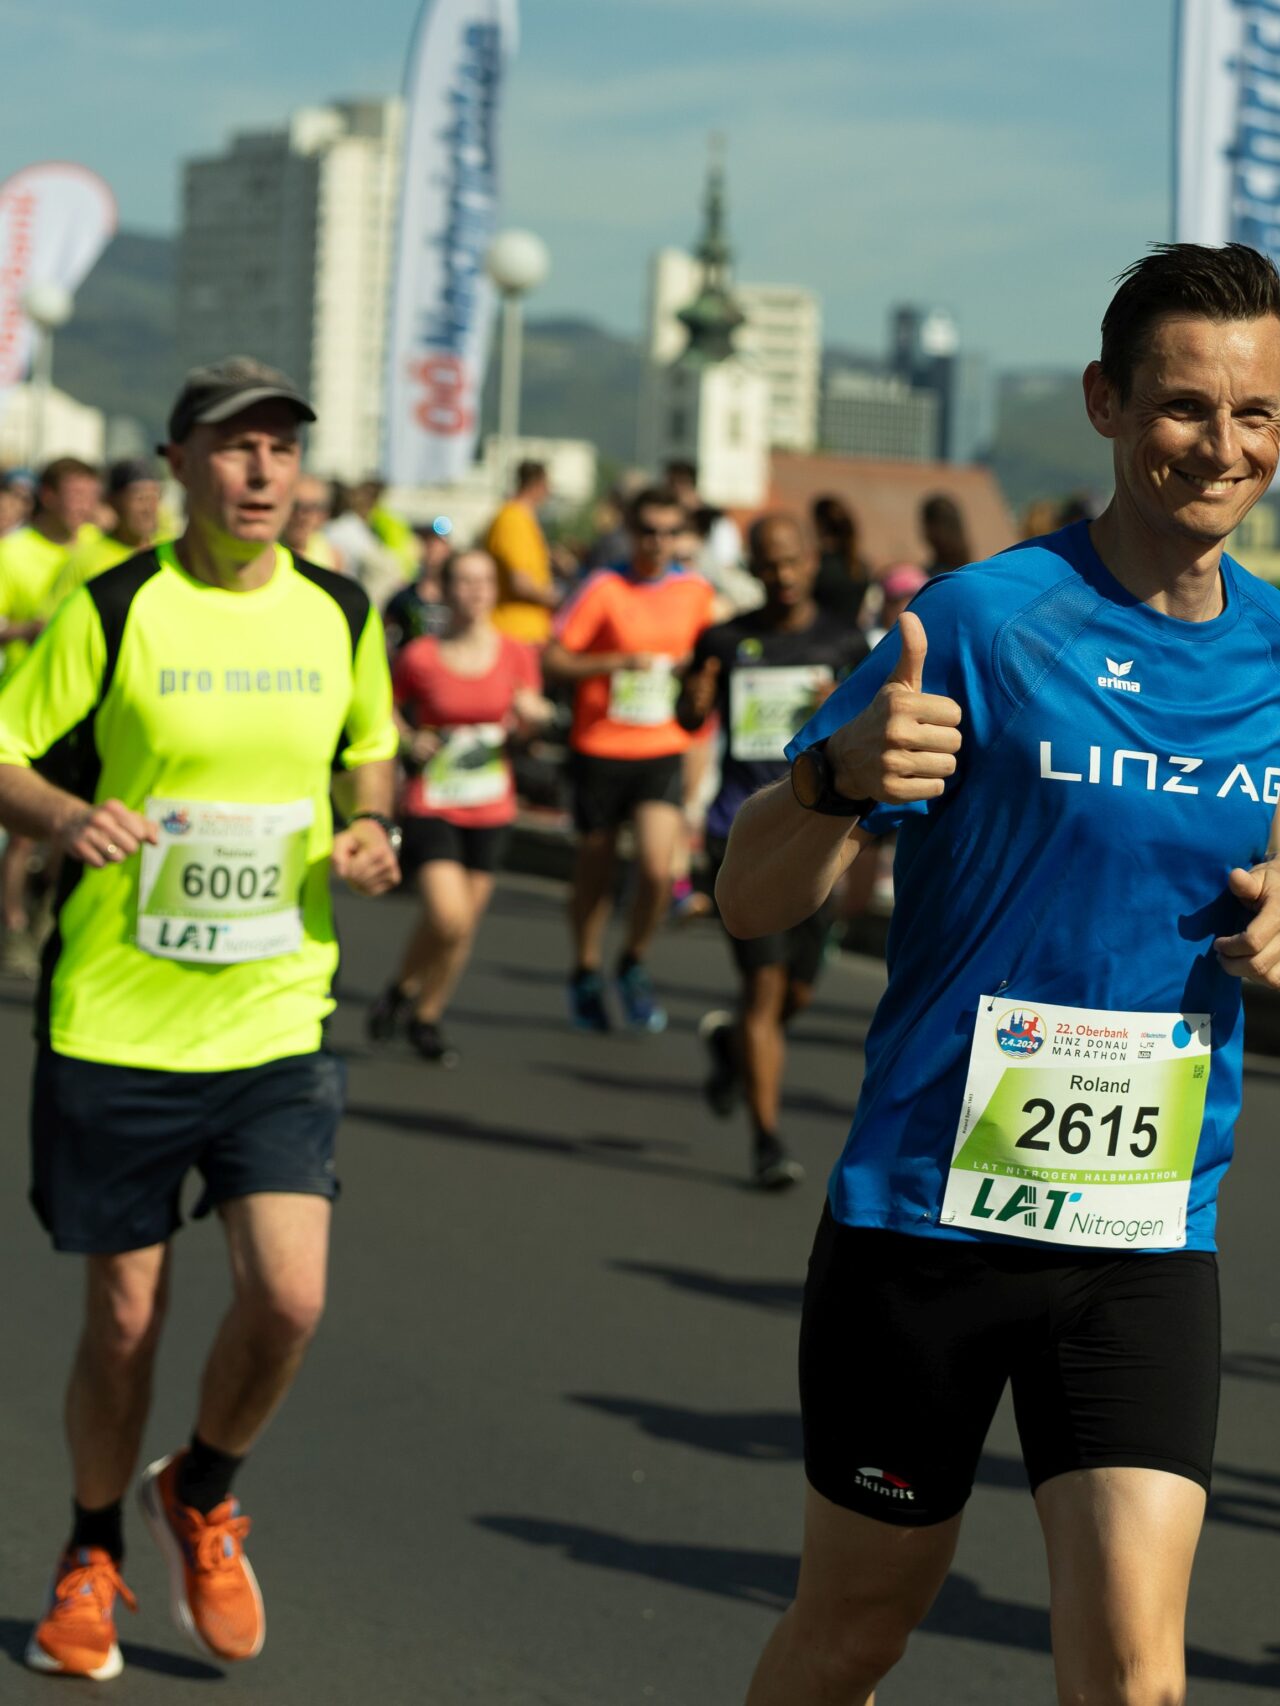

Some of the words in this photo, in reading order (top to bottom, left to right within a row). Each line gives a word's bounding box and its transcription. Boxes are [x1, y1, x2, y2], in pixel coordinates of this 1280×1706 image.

[159, 666, 213, 696] pro
[224, 667, 323, 693] mente
[1097, 676, 1141, 693] erima
[181, 862, 282, 900] 6002
[157, 918, 223, 952] LAT
[1056, 1023, 1073, 1035] 22.
[1076, 1025, 1129, 1039] Oberbank
[1000, 1036, 1039, 1050] 7.4.2024
[1053, 1036, 1080, 1047] LINZ
[1087, 1039, 1128, 1050] DONAU
[1052, 1047, 1127, 1061] MARATHON
[1069, 1075, 1131, 1094] Roland
[1014, 1097, 1160, 1159] 2615
[973, 1161, 997, 1172] LAT
[1006, 1166, 1078, 1181] NITROGEN
[1085, 1170, 1178, 1182] HALBMARATHON
[970, 1177, 1071, 1231] LAT
[1069, 1212, 1164, 1242] Nitrogen
[854, 1475, 915, 1501] skinfit
